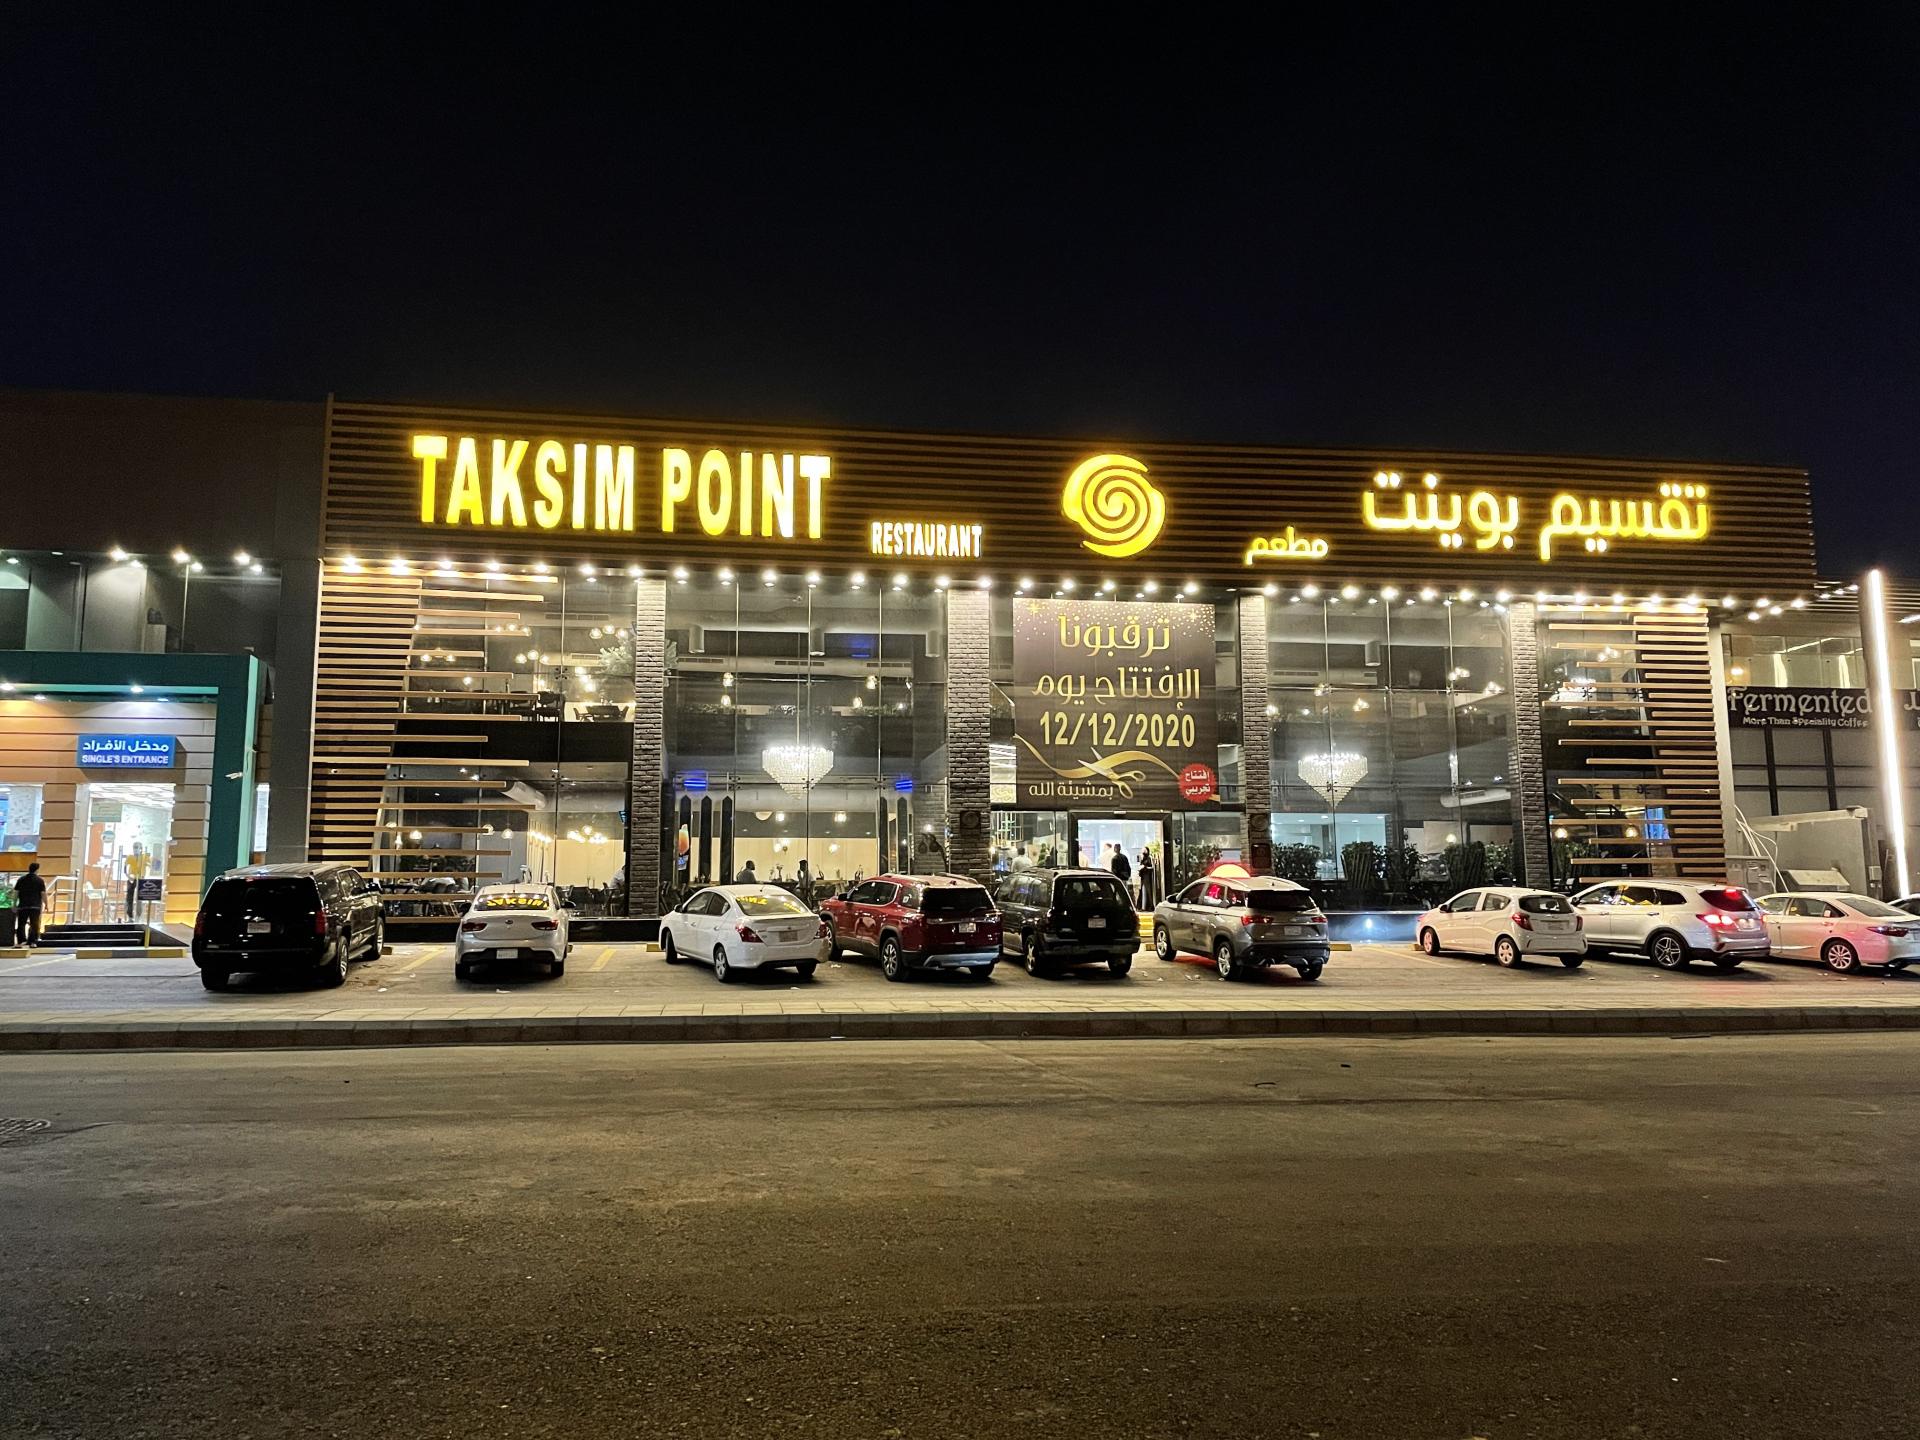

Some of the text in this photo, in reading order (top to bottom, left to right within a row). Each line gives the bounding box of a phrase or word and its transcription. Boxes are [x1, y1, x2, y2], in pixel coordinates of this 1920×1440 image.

[412, 435, 831, 539] TAKSIM POINT
[1362, 472, 1708, 560] تقسيم بوينت
[871, 521, 983, 558] RESTAURANT
[1244, 525, 1328, 565] مطعم
[1058, 615, 1170, 658] ترقبونا
[1032, 665, 1200, 711] الإفتتاح يوم
[1727, 686, 1873, 717] Fermented
[1039, 711, 1195, 748] 12/12/2020
[1742, 717, 1767, 726] More
[1767, 716, 1791, 725] Than
[81, 754, 169, 764] SINGLE'S ENTRANCE
[82, 739, 169, 753] مدخل الأفراد
[1029, 782, 1114, 800] بمشيئة الله
